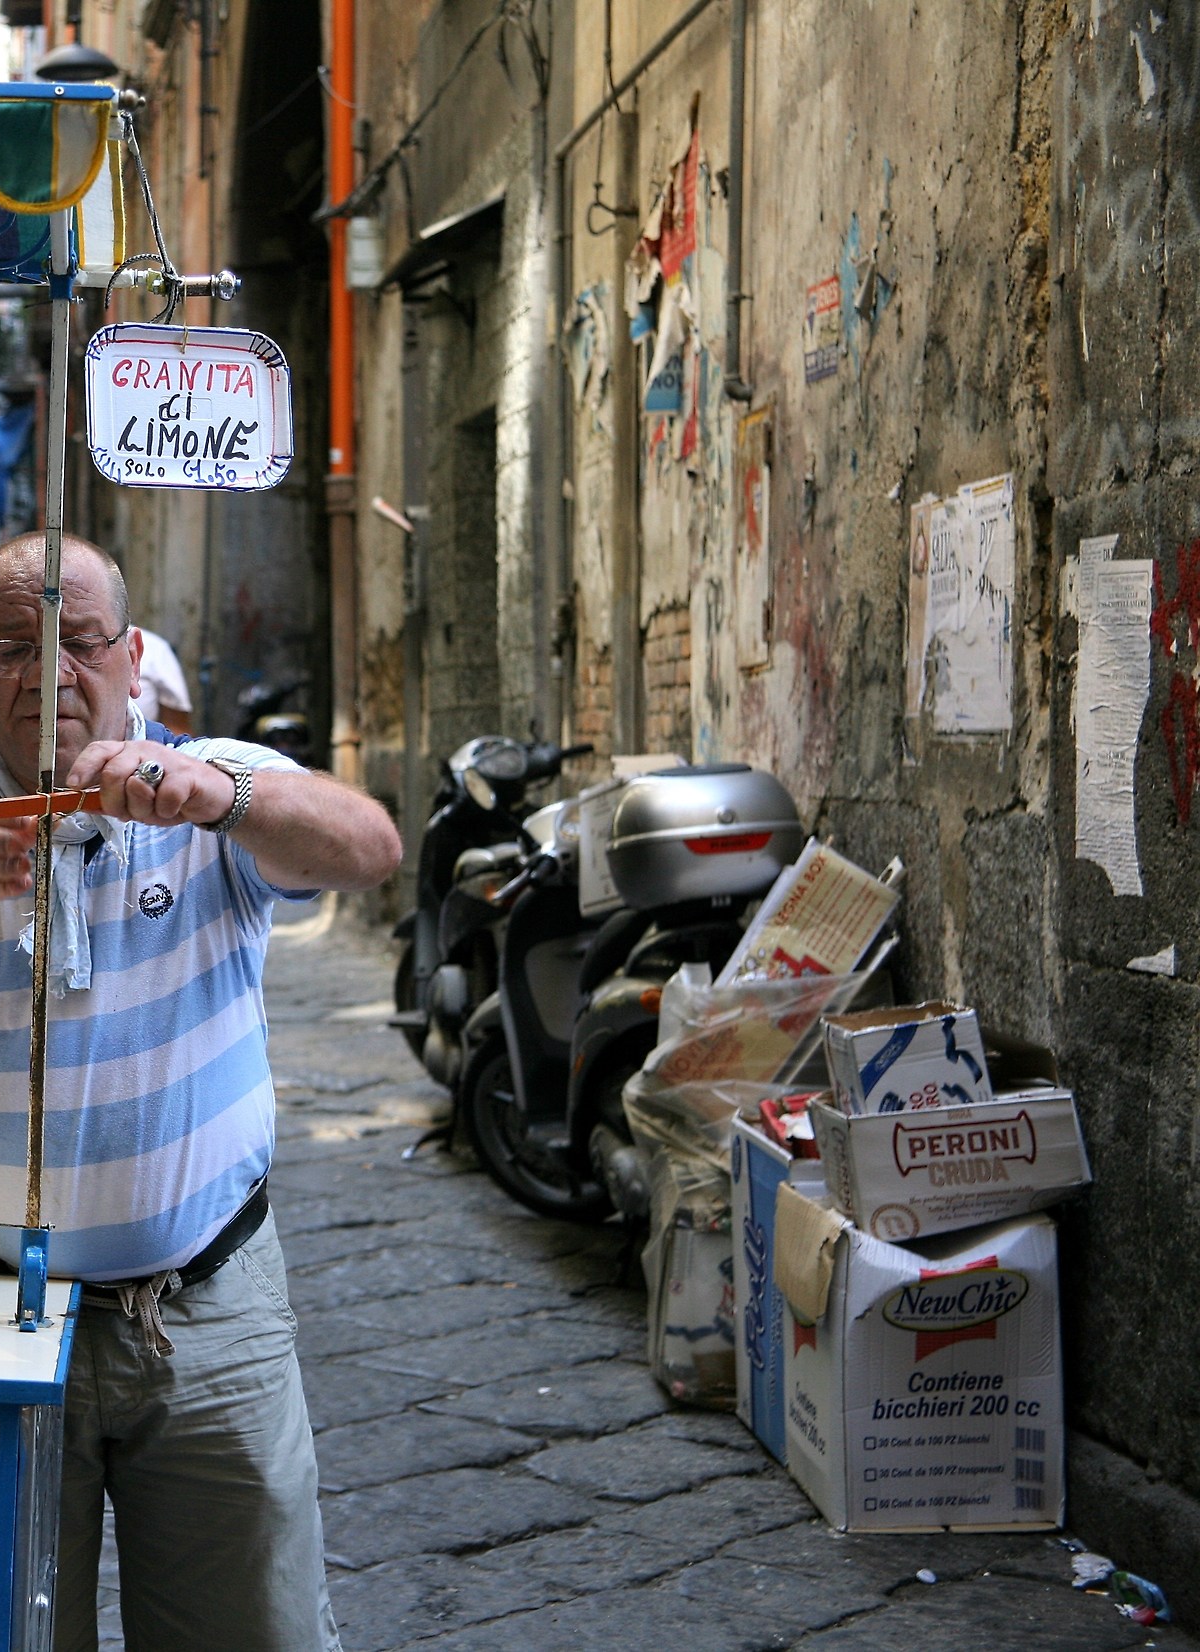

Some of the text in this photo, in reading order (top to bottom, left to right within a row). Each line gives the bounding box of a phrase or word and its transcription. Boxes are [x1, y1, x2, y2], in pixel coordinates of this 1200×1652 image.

[112, 359, 253, 398] GRANITA
[907, 1126, 1021, 1159] PERONI
[927, 1158, 1009, 1187] CRUDA
[907, 1370, 1003, 1393] Contiene
[872, 1395, 1041, 1421] bicchieri 200 cc
[928, 1436, 943, 1445] 100
[945, 1435, 957, 1445] PZ
[958, 1434, 990, 1445] bianchi
[928, 1467, 943, 1476] 100
[945, 1466, 957, 1476] PZ
[928, 1497, 943, 1506] 100
[945, 1496, 957, 1506] PZ
